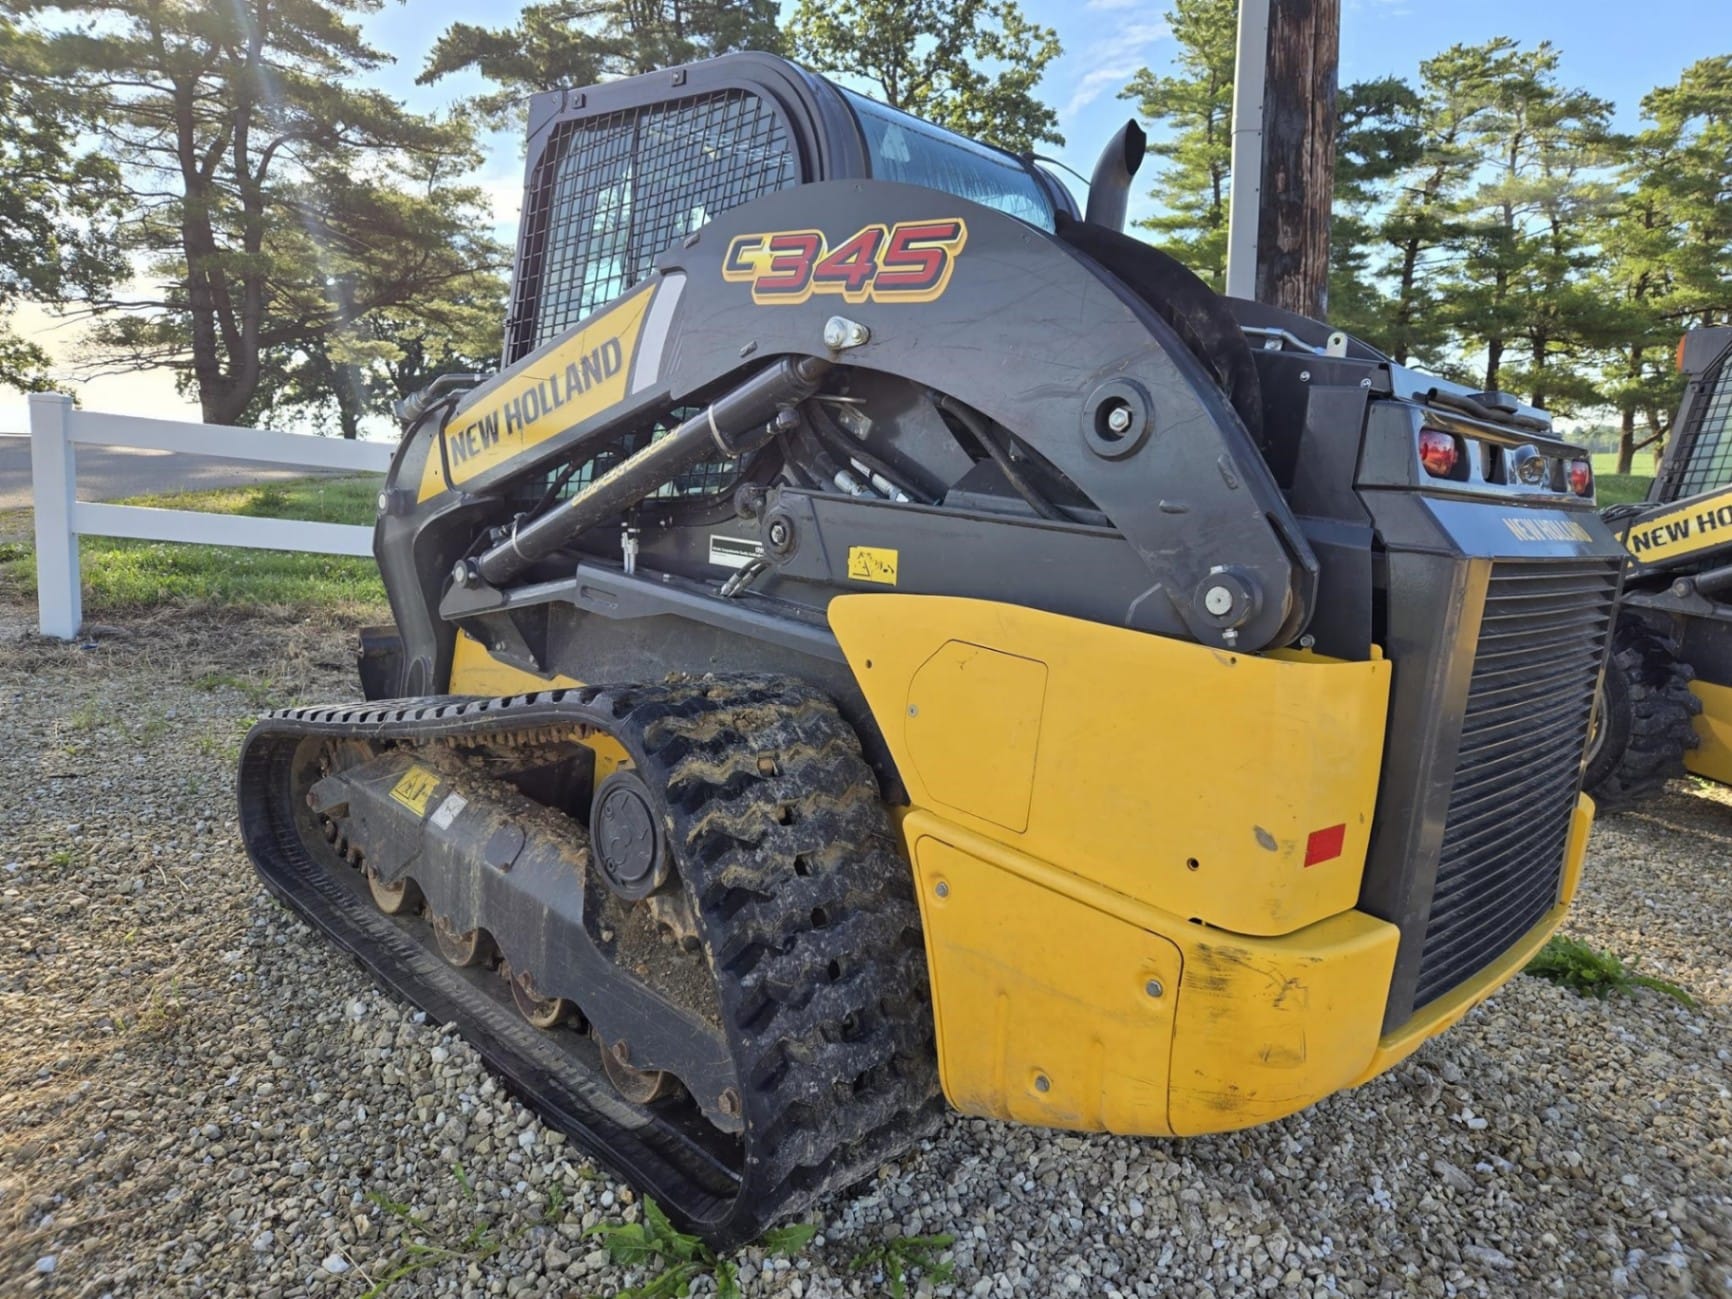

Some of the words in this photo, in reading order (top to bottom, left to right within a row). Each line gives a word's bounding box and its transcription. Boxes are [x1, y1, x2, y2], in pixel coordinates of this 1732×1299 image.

[722, 217, 968, 305] C345
[450, 408, 499, 466] NEW
[504, 336, 623, 435] HOLLAND
[1502, 518, 1547, 541] NEW
[1632, 518, 1690, 553] NEW
